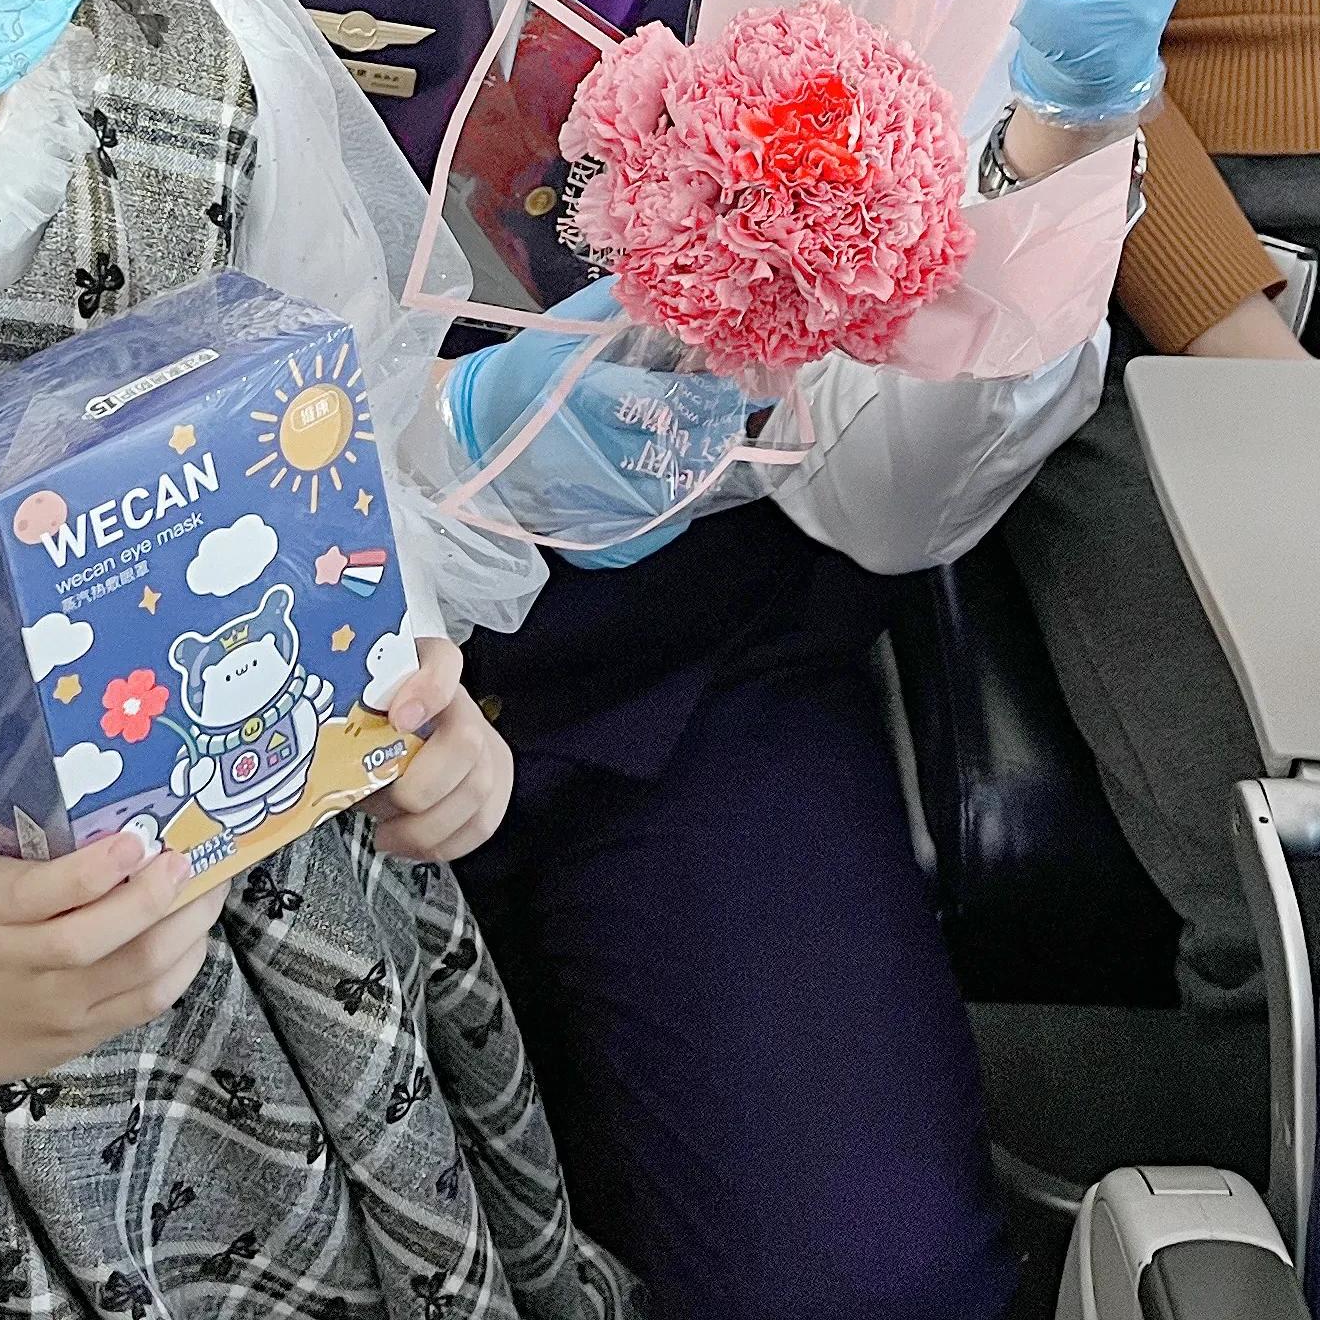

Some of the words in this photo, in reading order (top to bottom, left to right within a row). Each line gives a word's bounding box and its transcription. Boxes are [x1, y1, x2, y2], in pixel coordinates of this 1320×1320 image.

[40, 452, 220, 568] WECAN
[55, 557, 116, 595] wecan
[120, 539, 153, 564] eye
[156, 512, 204, 547] mask
